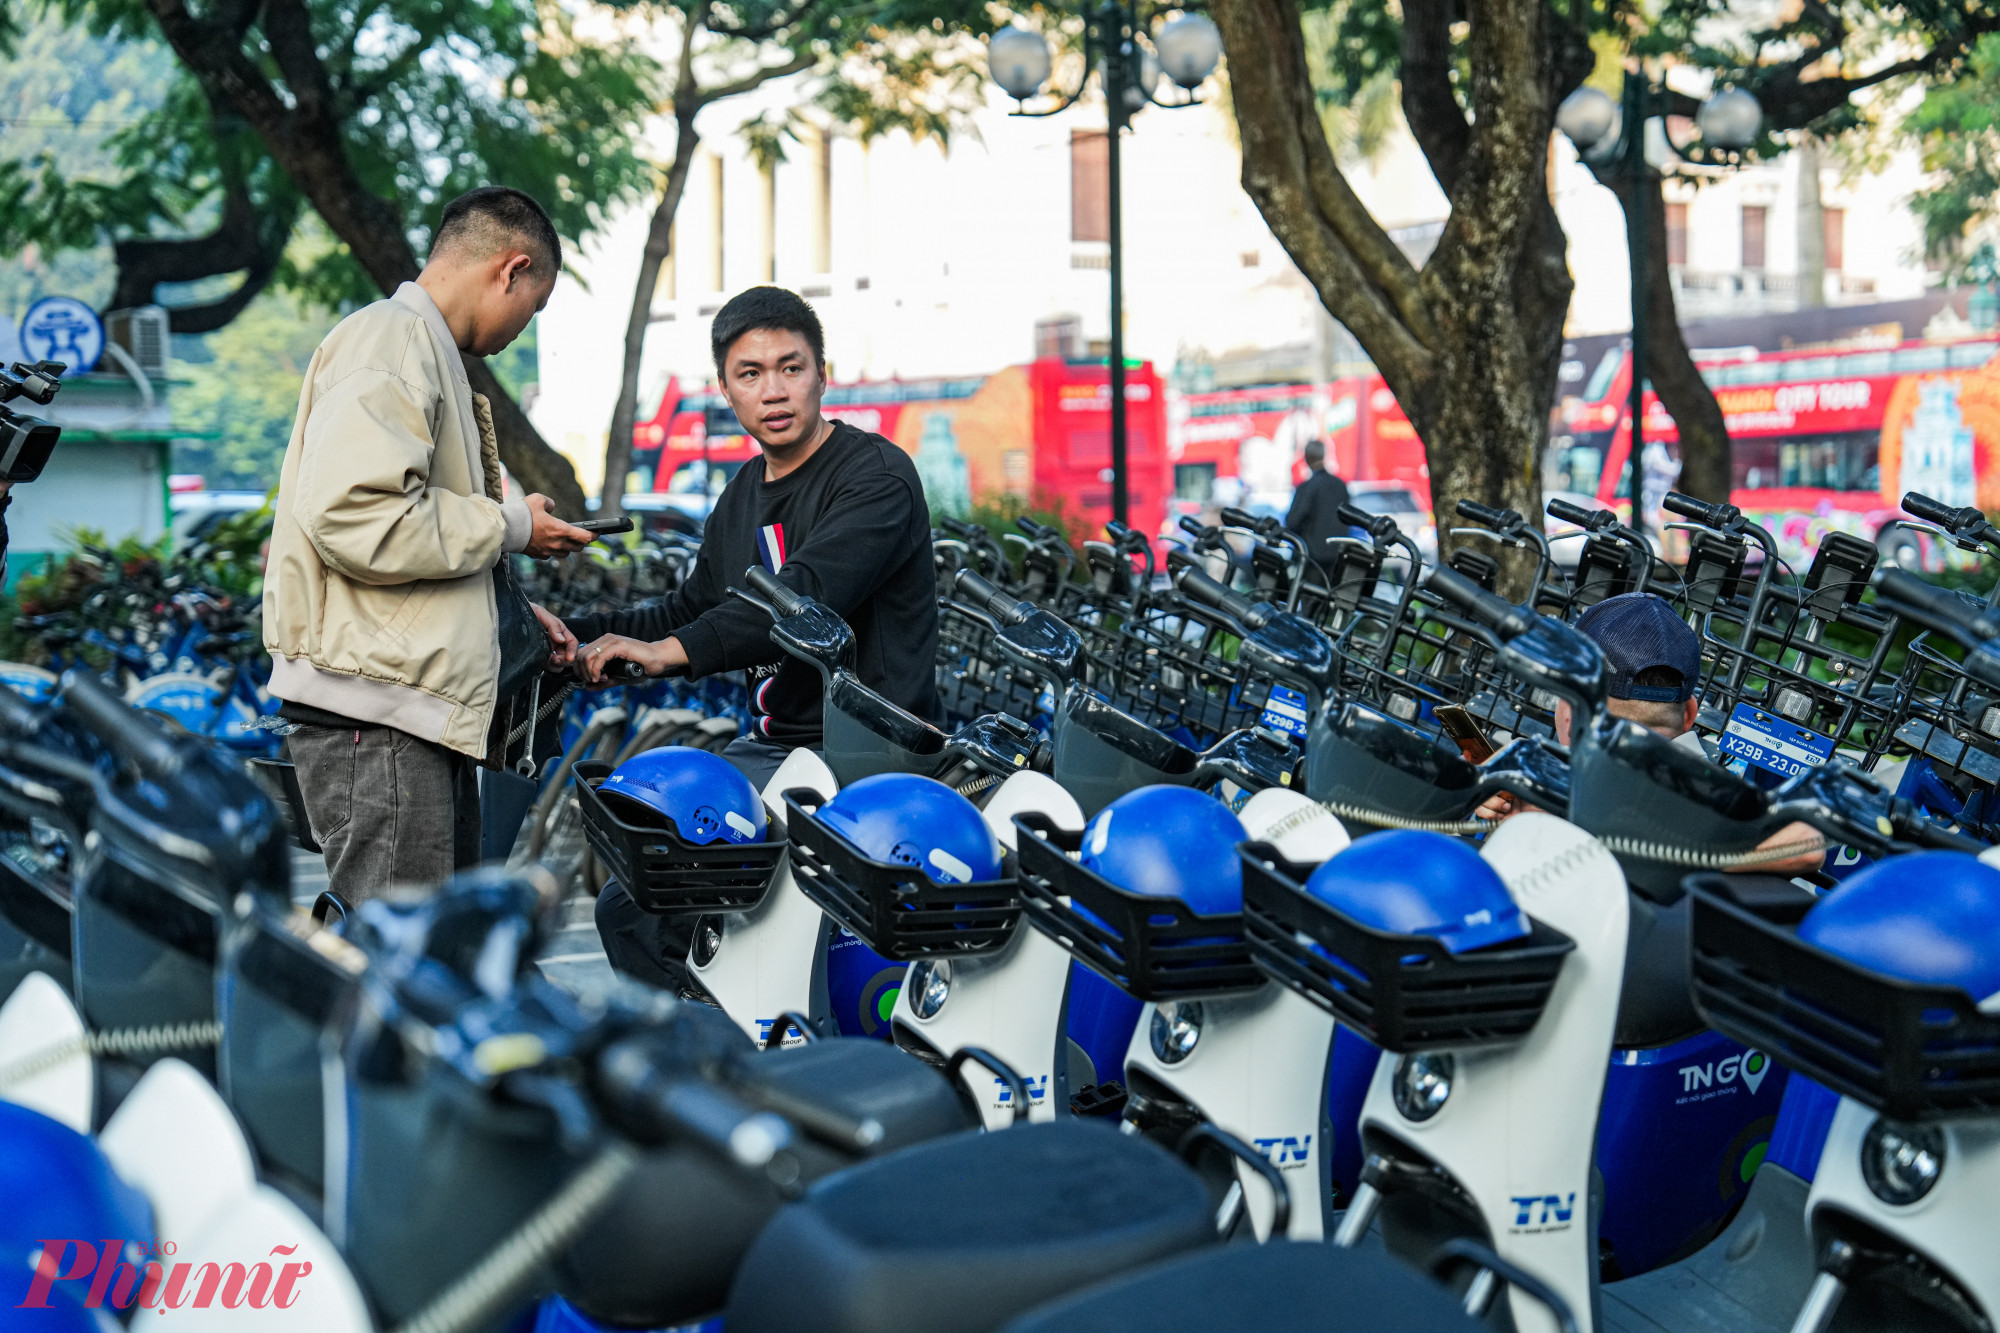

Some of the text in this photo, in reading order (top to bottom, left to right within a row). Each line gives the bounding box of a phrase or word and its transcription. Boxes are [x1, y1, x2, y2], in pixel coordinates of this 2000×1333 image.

[1818, 381, 1871, 411] TOUR
[1264, 711, 1307, 736] X29B-2
[781, 1038, 802, 1046] GROUP
[1254, 1135, 1311, 1163] TN
[1510, 1192, 1576, 1225] TN
